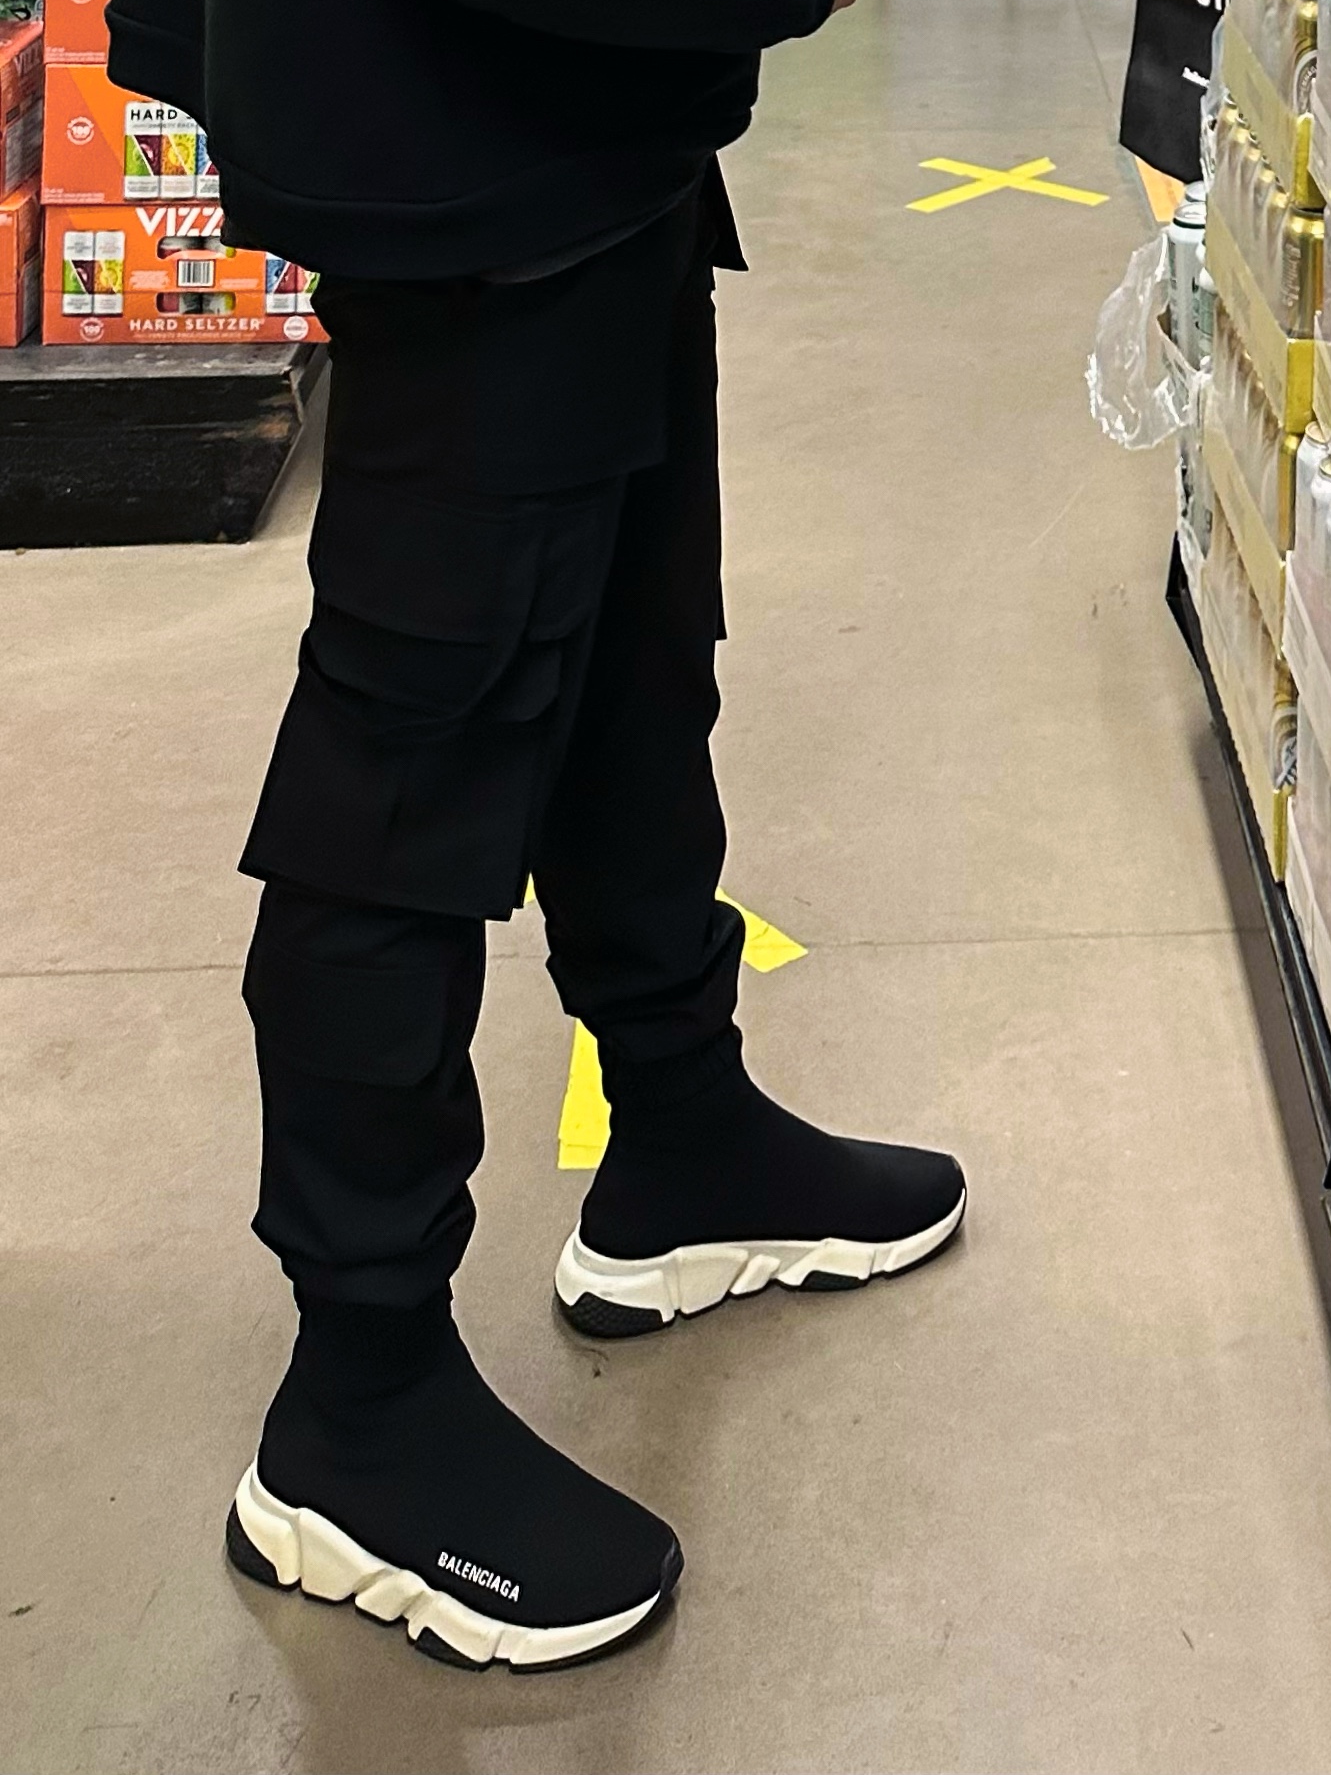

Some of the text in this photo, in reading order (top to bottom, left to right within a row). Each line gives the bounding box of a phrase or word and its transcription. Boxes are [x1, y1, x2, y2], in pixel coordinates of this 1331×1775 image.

[130, 108, 178, 122] HARD
[136, 208, 224, 237] VIZZ
[130, 319, 261, 332] HARD SELTZER
[437, 1551, 521, 1603] BALENCIAGA
